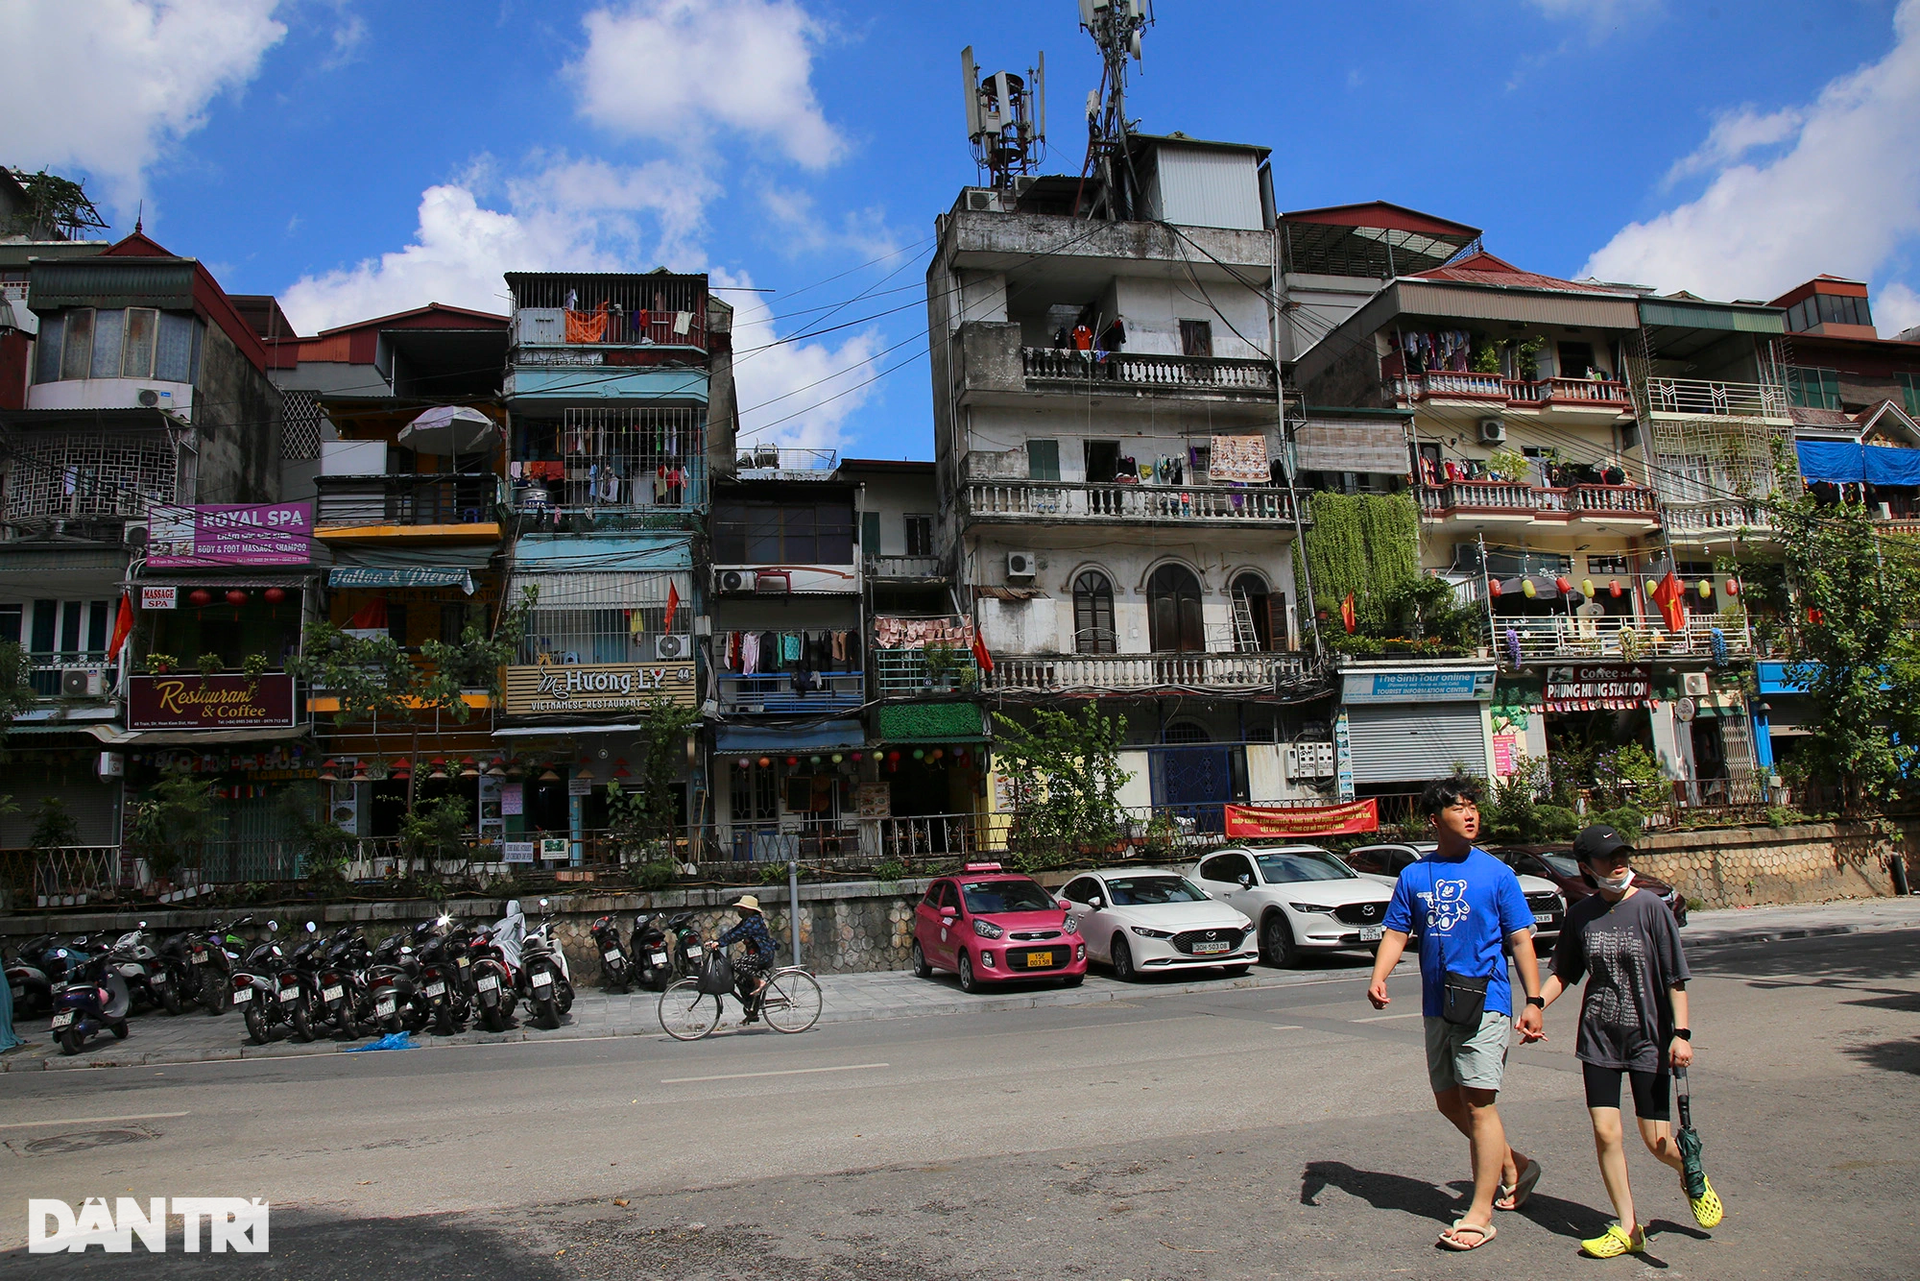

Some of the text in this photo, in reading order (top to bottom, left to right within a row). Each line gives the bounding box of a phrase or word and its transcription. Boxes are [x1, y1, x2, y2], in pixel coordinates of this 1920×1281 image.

[202, 510, 303, 527] ROYAL SPA
[197, 544, 215, 554] BODY
[217, 544, 222, 553] &
[223, 544, 240, 553] FOOT
[275, 542, 307, 552] SHAMPOO
[331, 568, 383, 584] Tattoo
[389, 568, 401, 584] &
[143, 589, 175, 599] MASSAGE
[147, 600, 168, 608] SPA
[678, 668, 690, 679] 44
[1379, 673, 1471, 683] The Sinh Tour online
[1547, 682, 1648, 698] PHUNG HUNG STATION
[156, 680, 257, 714] Restaurant
[201, 704, 266, 718] & Coffee
[531, 701, 583, 711] VIETNAMESE
[586, 699, 642, 710] RESTAURANT
[247, 769, 318, 780] FLOWER TEA
